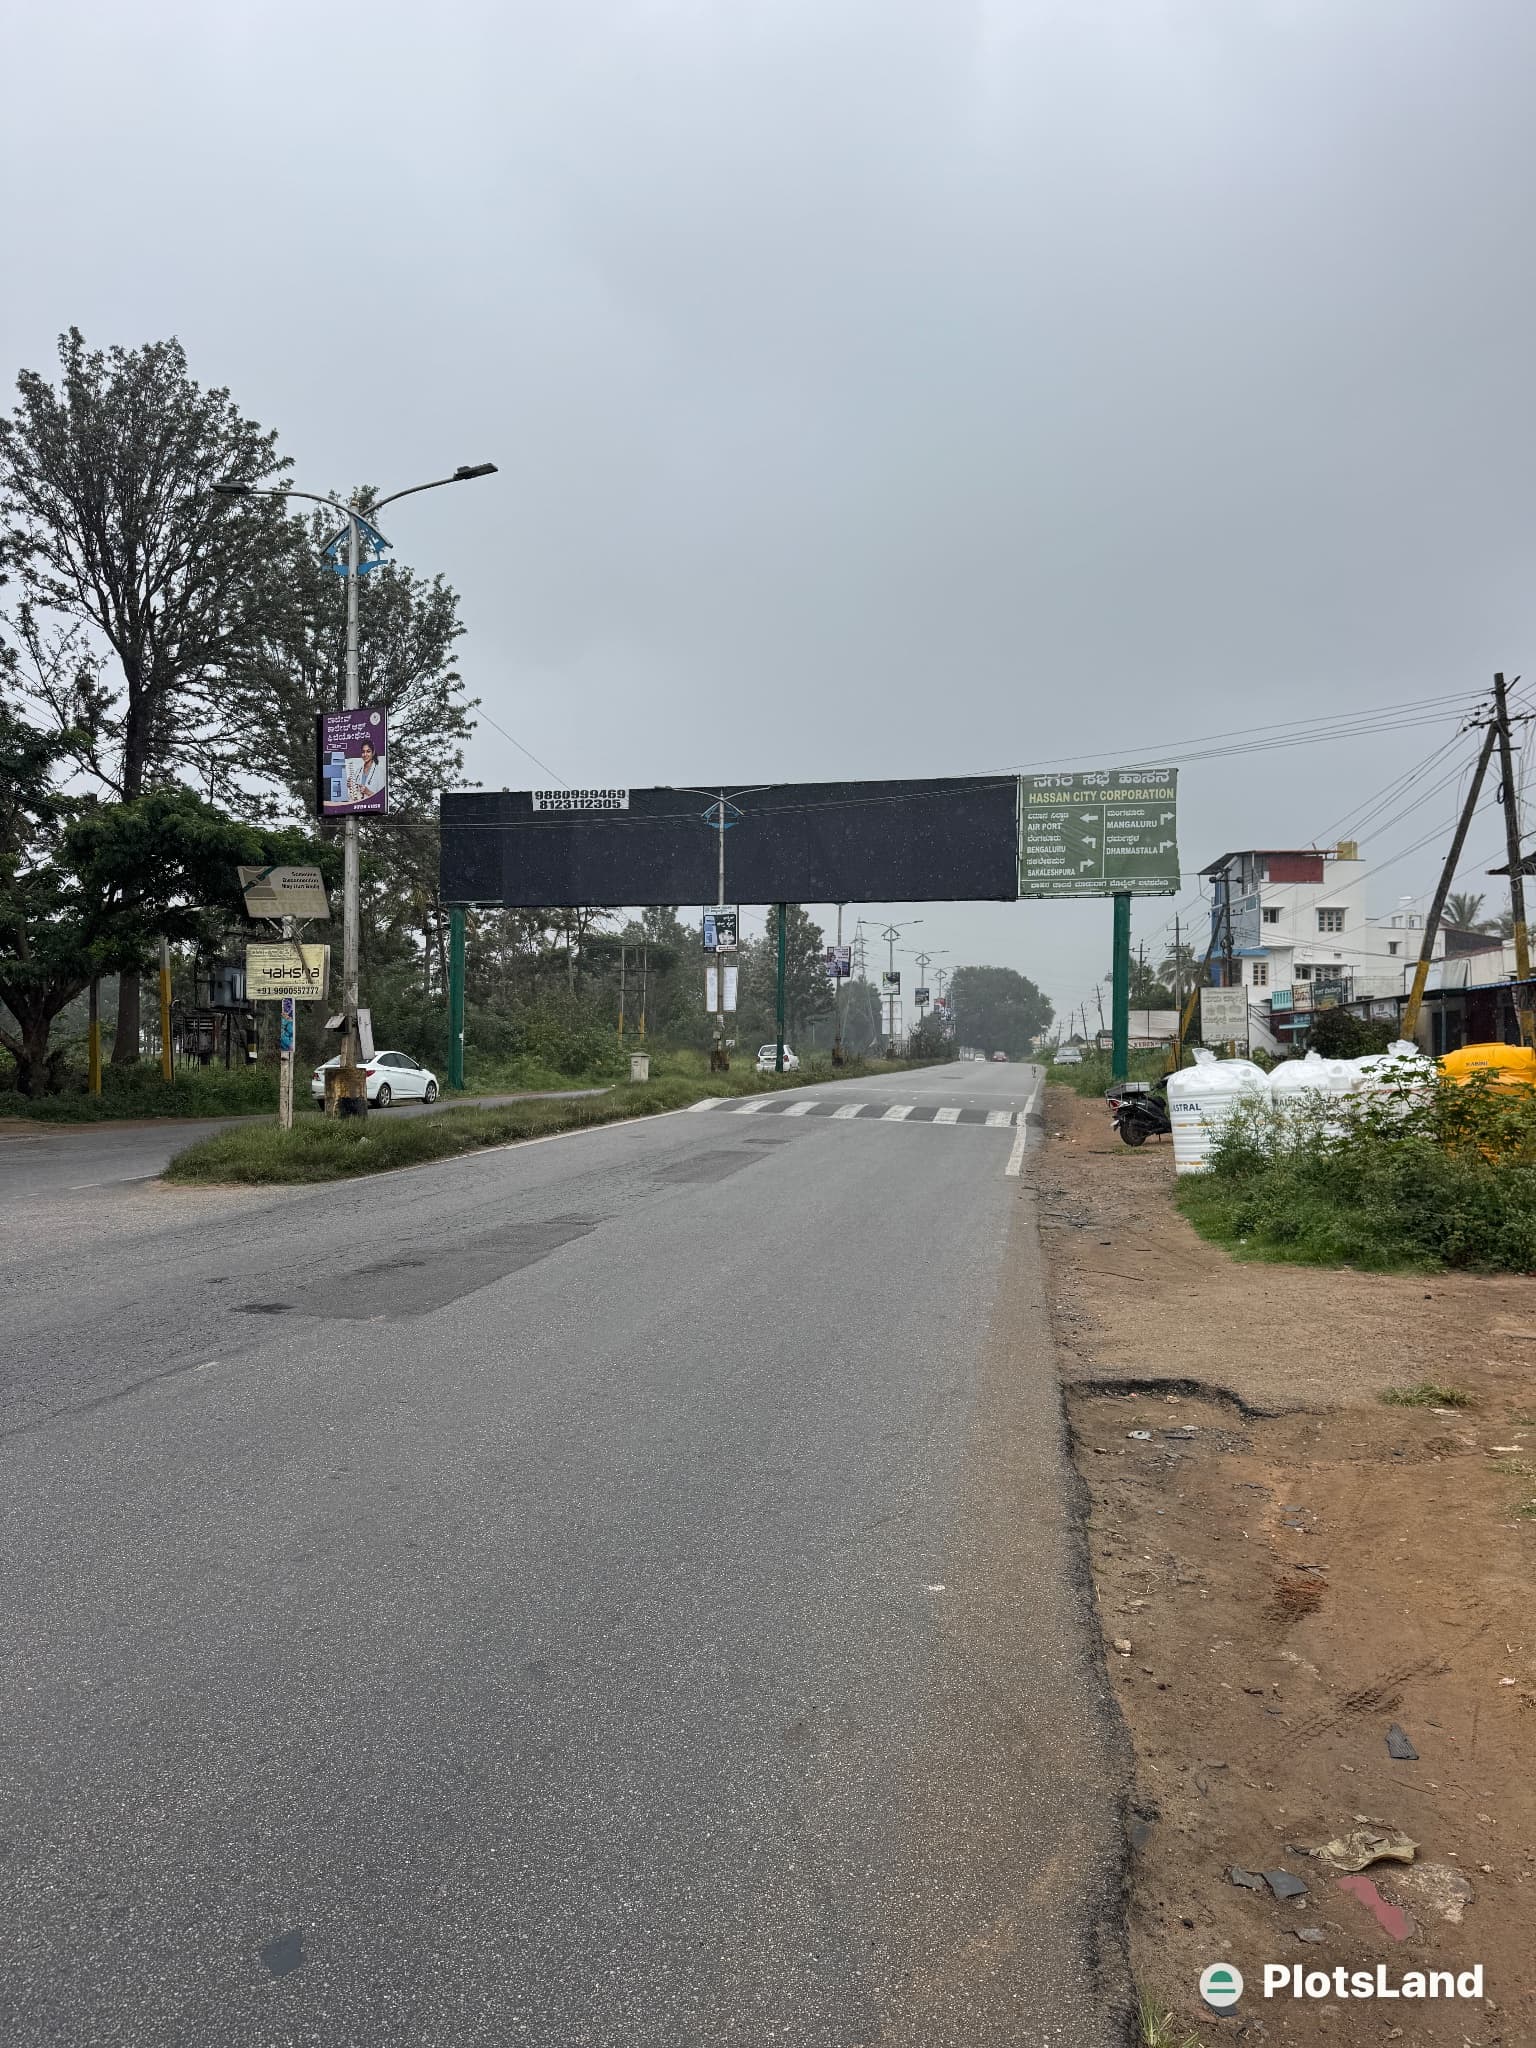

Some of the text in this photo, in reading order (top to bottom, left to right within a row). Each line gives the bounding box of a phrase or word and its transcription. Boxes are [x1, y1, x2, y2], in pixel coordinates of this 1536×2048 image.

[1033, 773, 1073, 787] ನಗರ
[1119, 769, 1170, 784] ಹಾಸನ
[535, 790, 625, 799] 9880999469
[1029, 788, 1174, 804] HASSAN CITY CORPORATION
[540, 799, 620, 809] 8123112305
[1027, 822, 1062, 831] AIR PORT
[1106, 820, 1157, 829] MANGALURU
[1026, 845, 1066, 854] BENGALURU
[1106, 847, 1158, 855] DHARMASTALA
[1027, 868, 1076, 877] SAKALESHPURA
